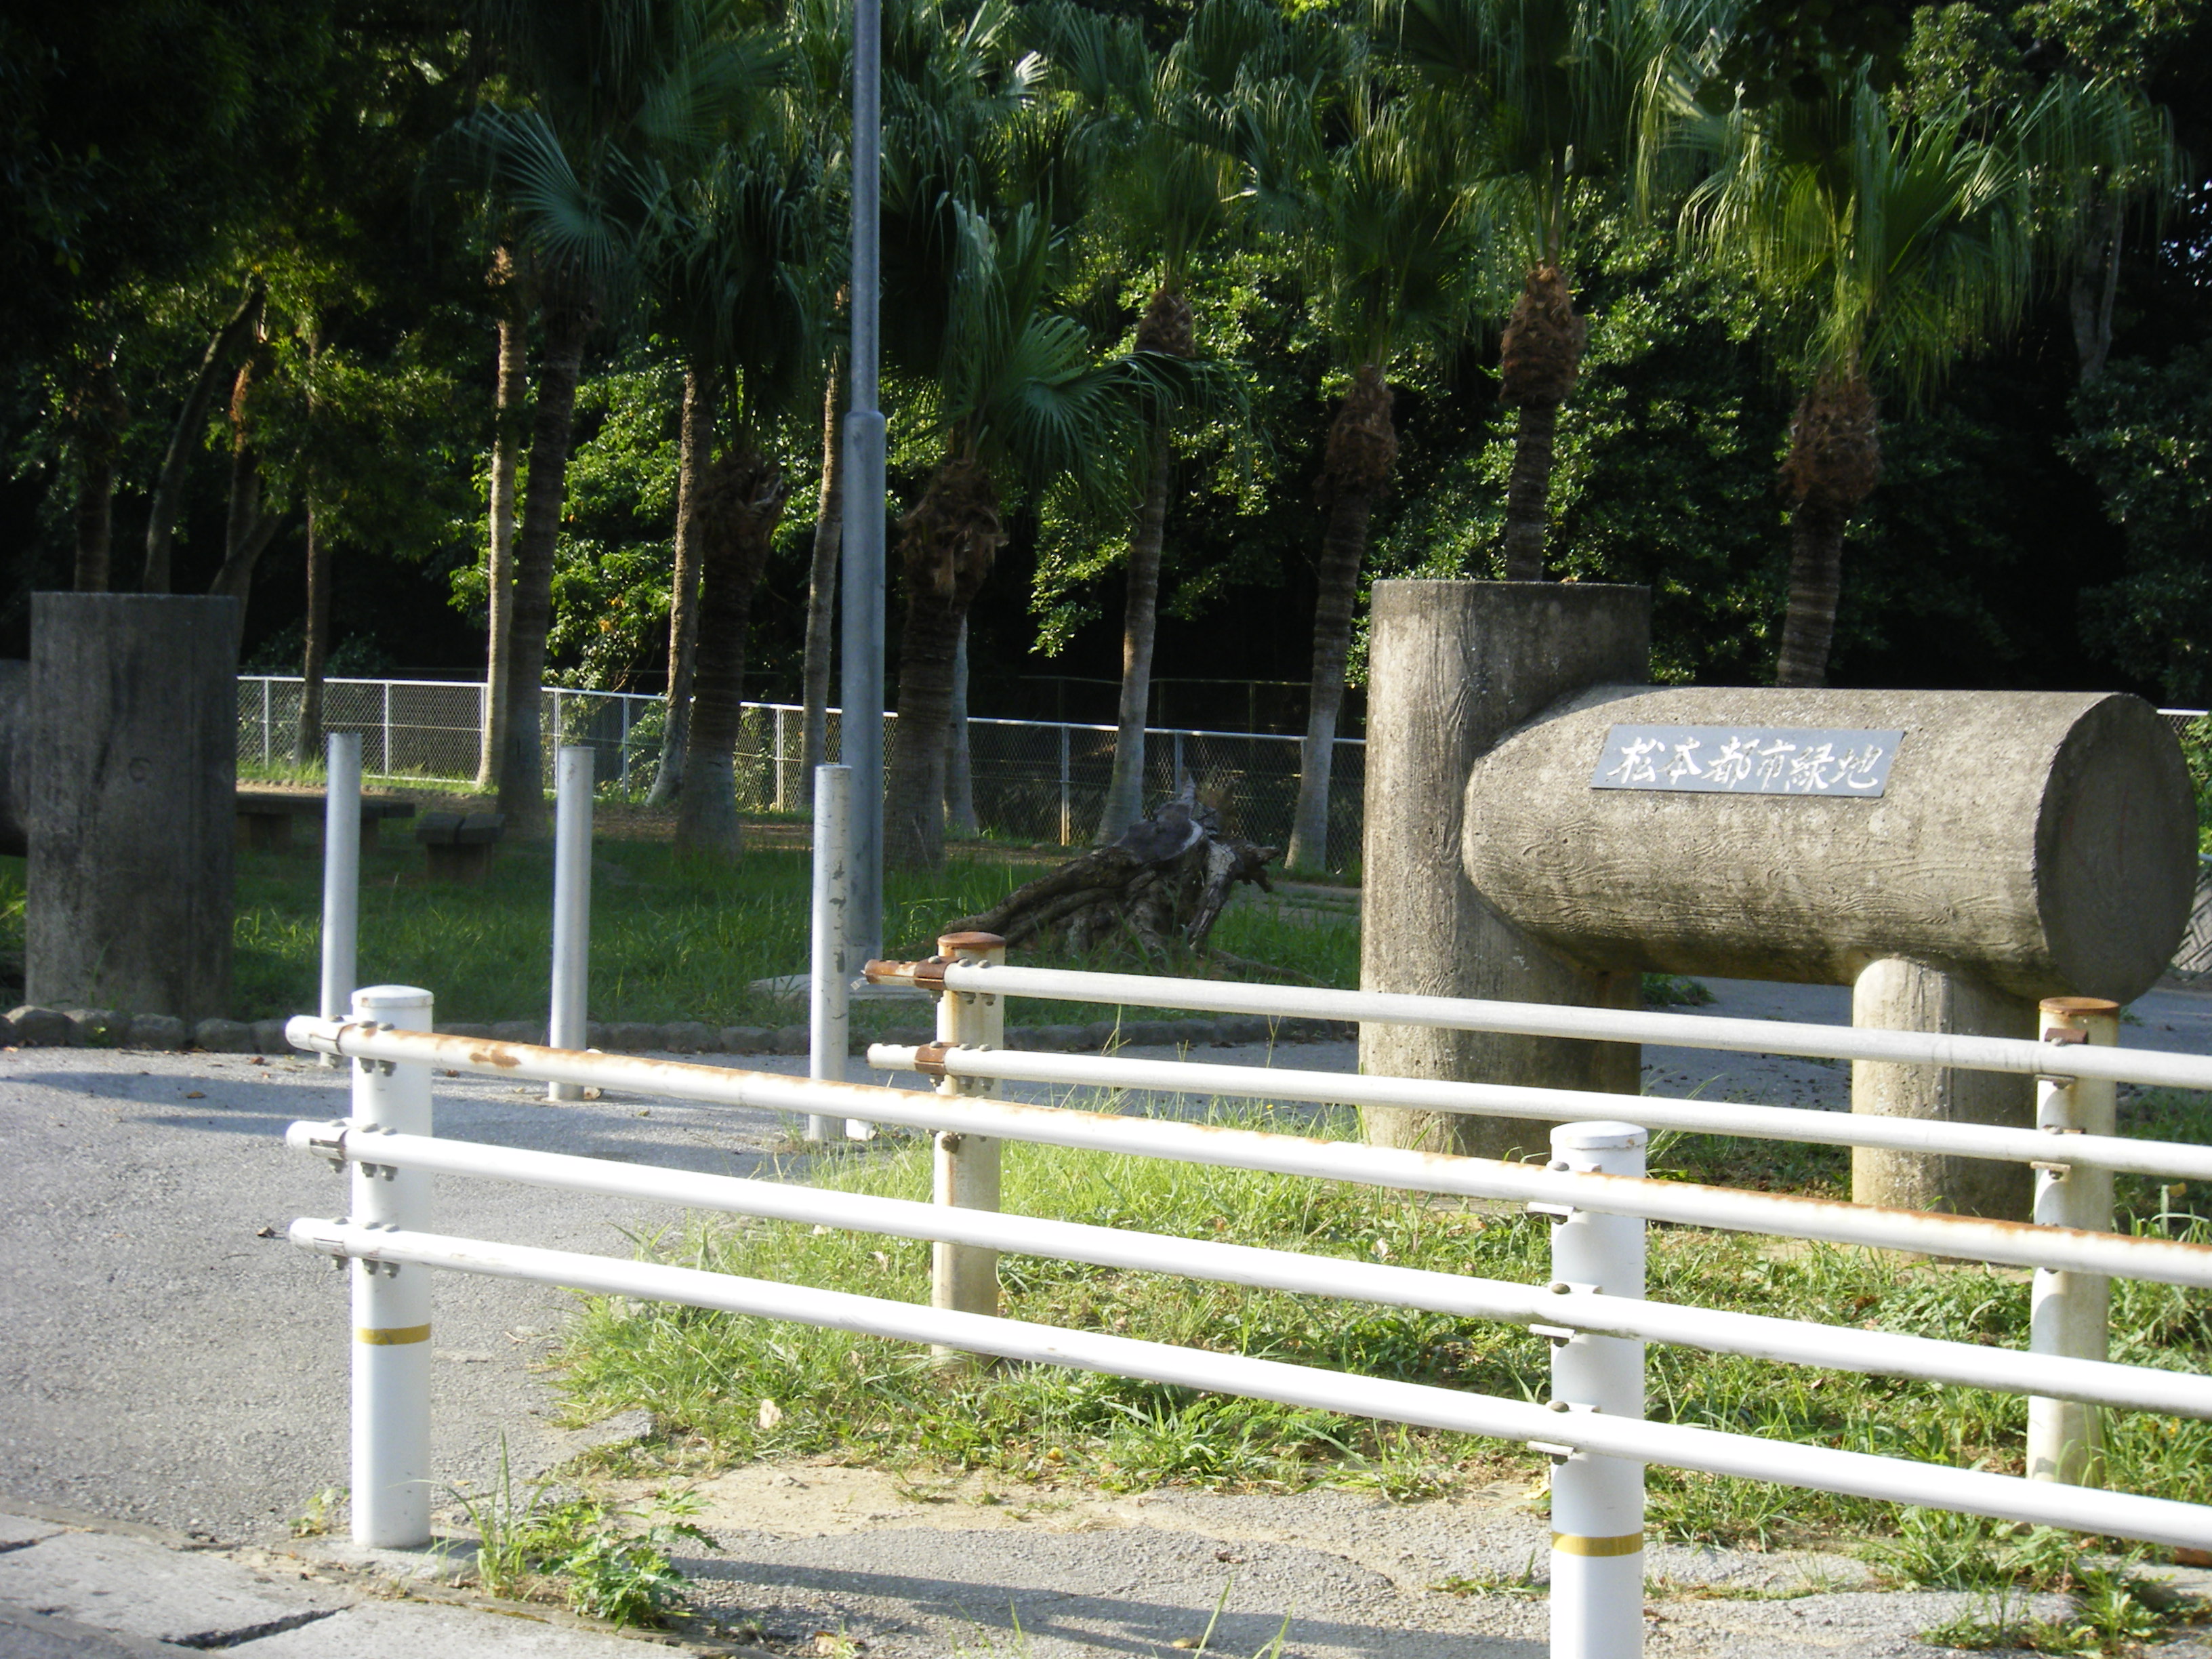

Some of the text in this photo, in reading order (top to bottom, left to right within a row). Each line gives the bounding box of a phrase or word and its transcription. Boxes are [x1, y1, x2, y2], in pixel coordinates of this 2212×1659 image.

[1607, 736, 1883, 792] 松本都市緑地
